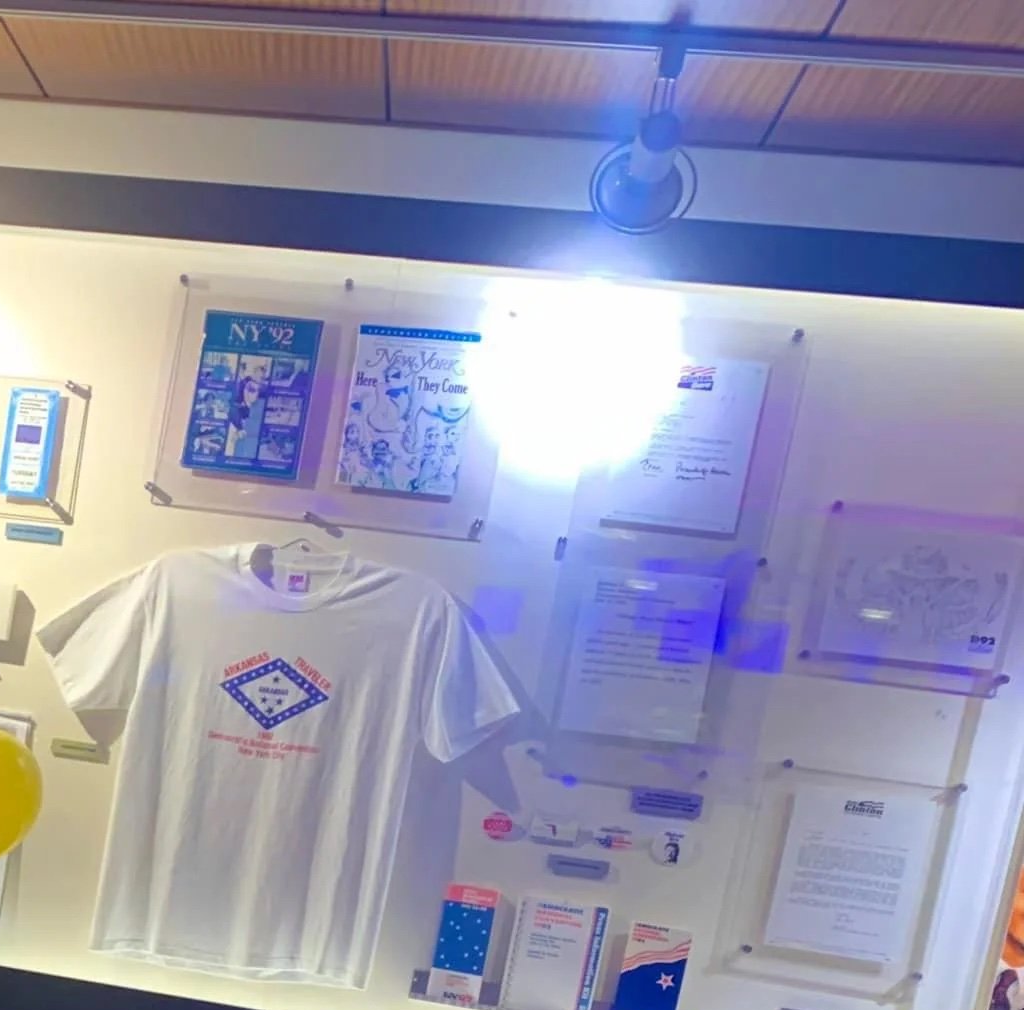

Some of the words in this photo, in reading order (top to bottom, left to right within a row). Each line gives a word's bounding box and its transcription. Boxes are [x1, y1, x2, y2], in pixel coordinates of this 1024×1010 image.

[227, 323, 266, 342] NY
[268, 326, 295, 345] '92
[355, 371, 379, 388] Here
[417, 375, 441, 395] They
[442, 377, 470, 395] Come
[223, 651, 272, 677] ARKANSAS
[293, 656, 332, 691] TRAVELER
